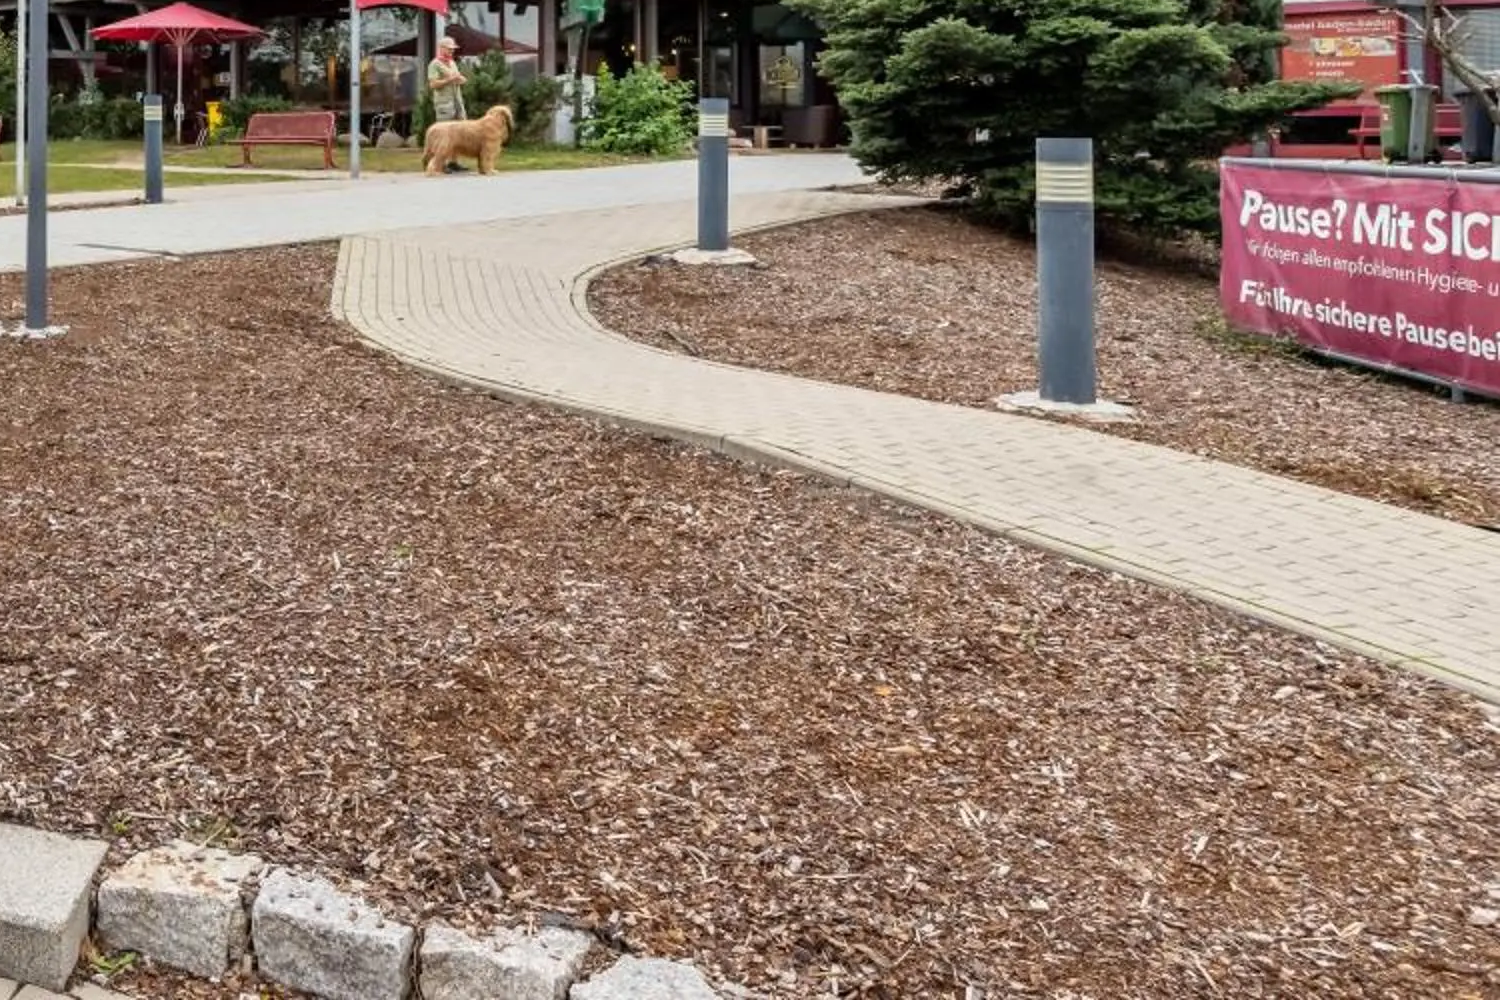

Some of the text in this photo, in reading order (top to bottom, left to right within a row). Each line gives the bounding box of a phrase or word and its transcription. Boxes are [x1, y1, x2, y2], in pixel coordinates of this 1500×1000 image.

[1239, 189, 1348, 241] Pause?
[1352, 202, 1416, 251] Mit
[1301, 247, 1332, 268] allen
[1273, 286, 1314, 319] Ihre
[1315, 297, 1393, 337] sichere
[1395, 311, 1467, 352] Pause
